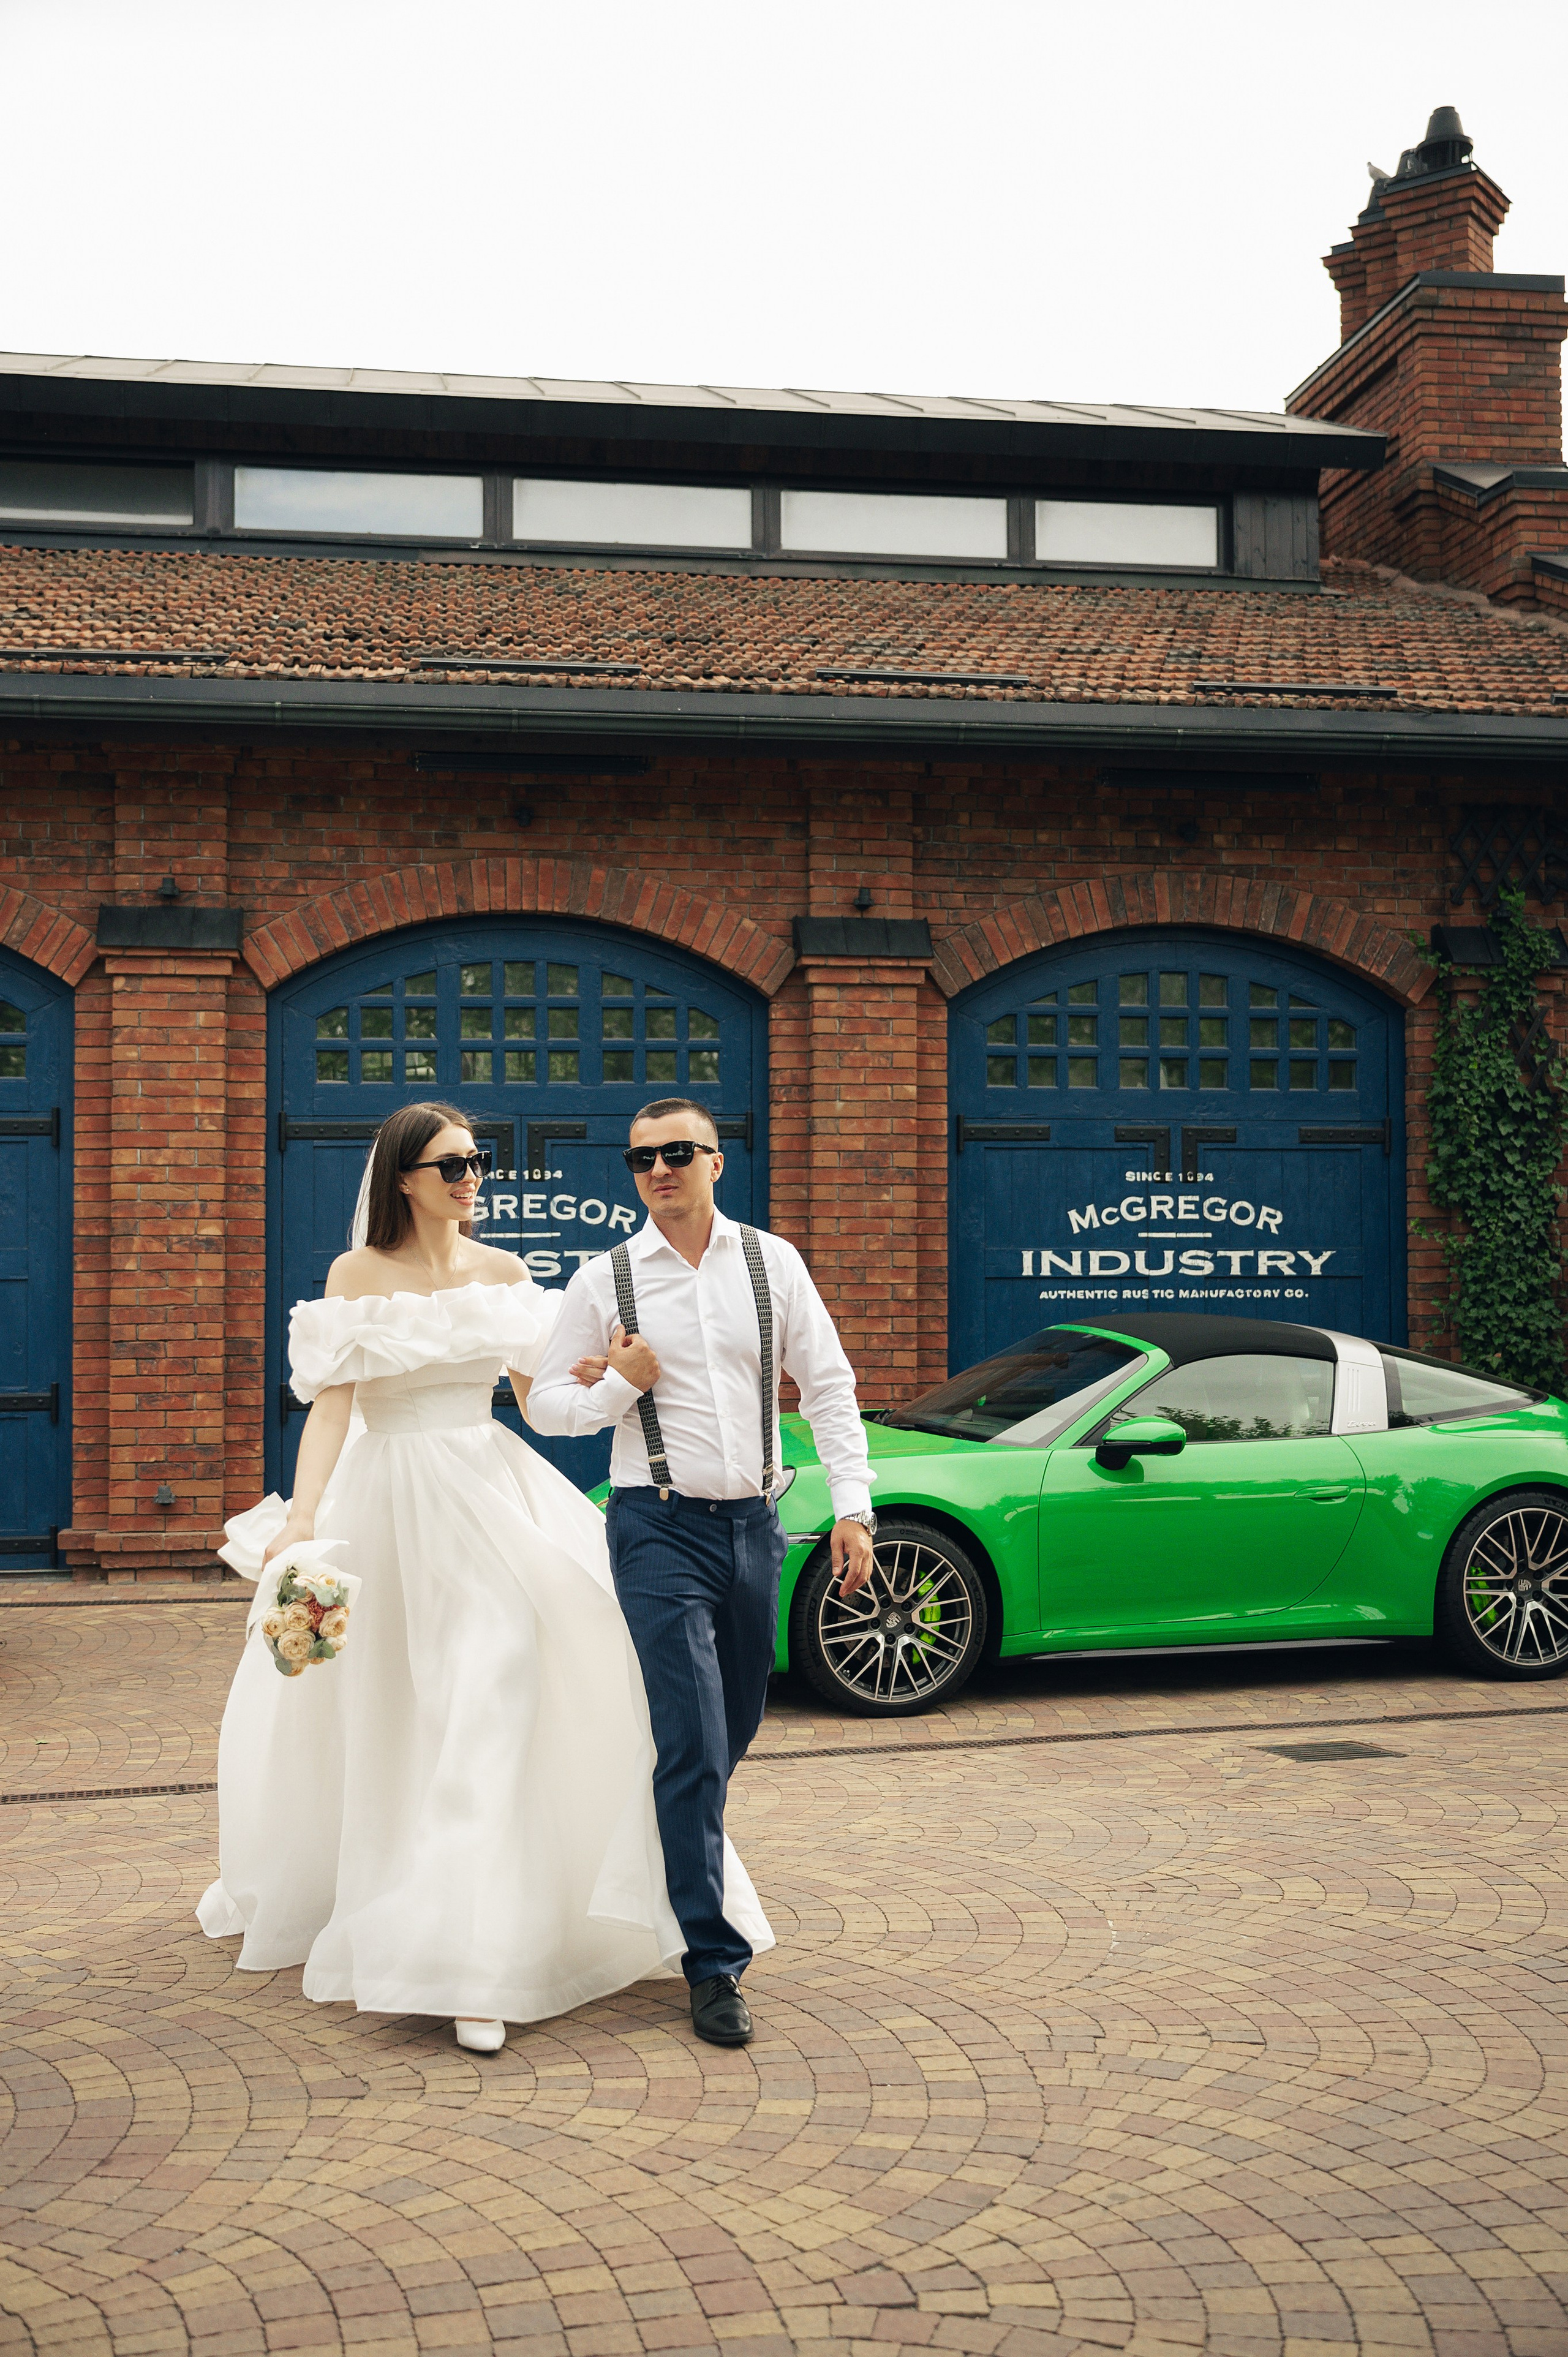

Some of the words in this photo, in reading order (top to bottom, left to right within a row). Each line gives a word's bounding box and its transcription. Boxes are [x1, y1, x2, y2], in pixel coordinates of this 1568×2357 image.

[484, 1169, 518, 1180] NCE
[1125, 1171, 1173, 1182] SINCE
[471, 1194, 636, 1234] GREGOR
[1067, 1194, 1283, 1235] McGREGOR
[1021, 1250, 1336, 1276] INDUSTRY
[1039, 1289, 1118, 1299] AUTHENTIC
[1178, 1288, 1280, 1299] MANUFACTORY
[1284, 1289, 1309, 1298] CO.
